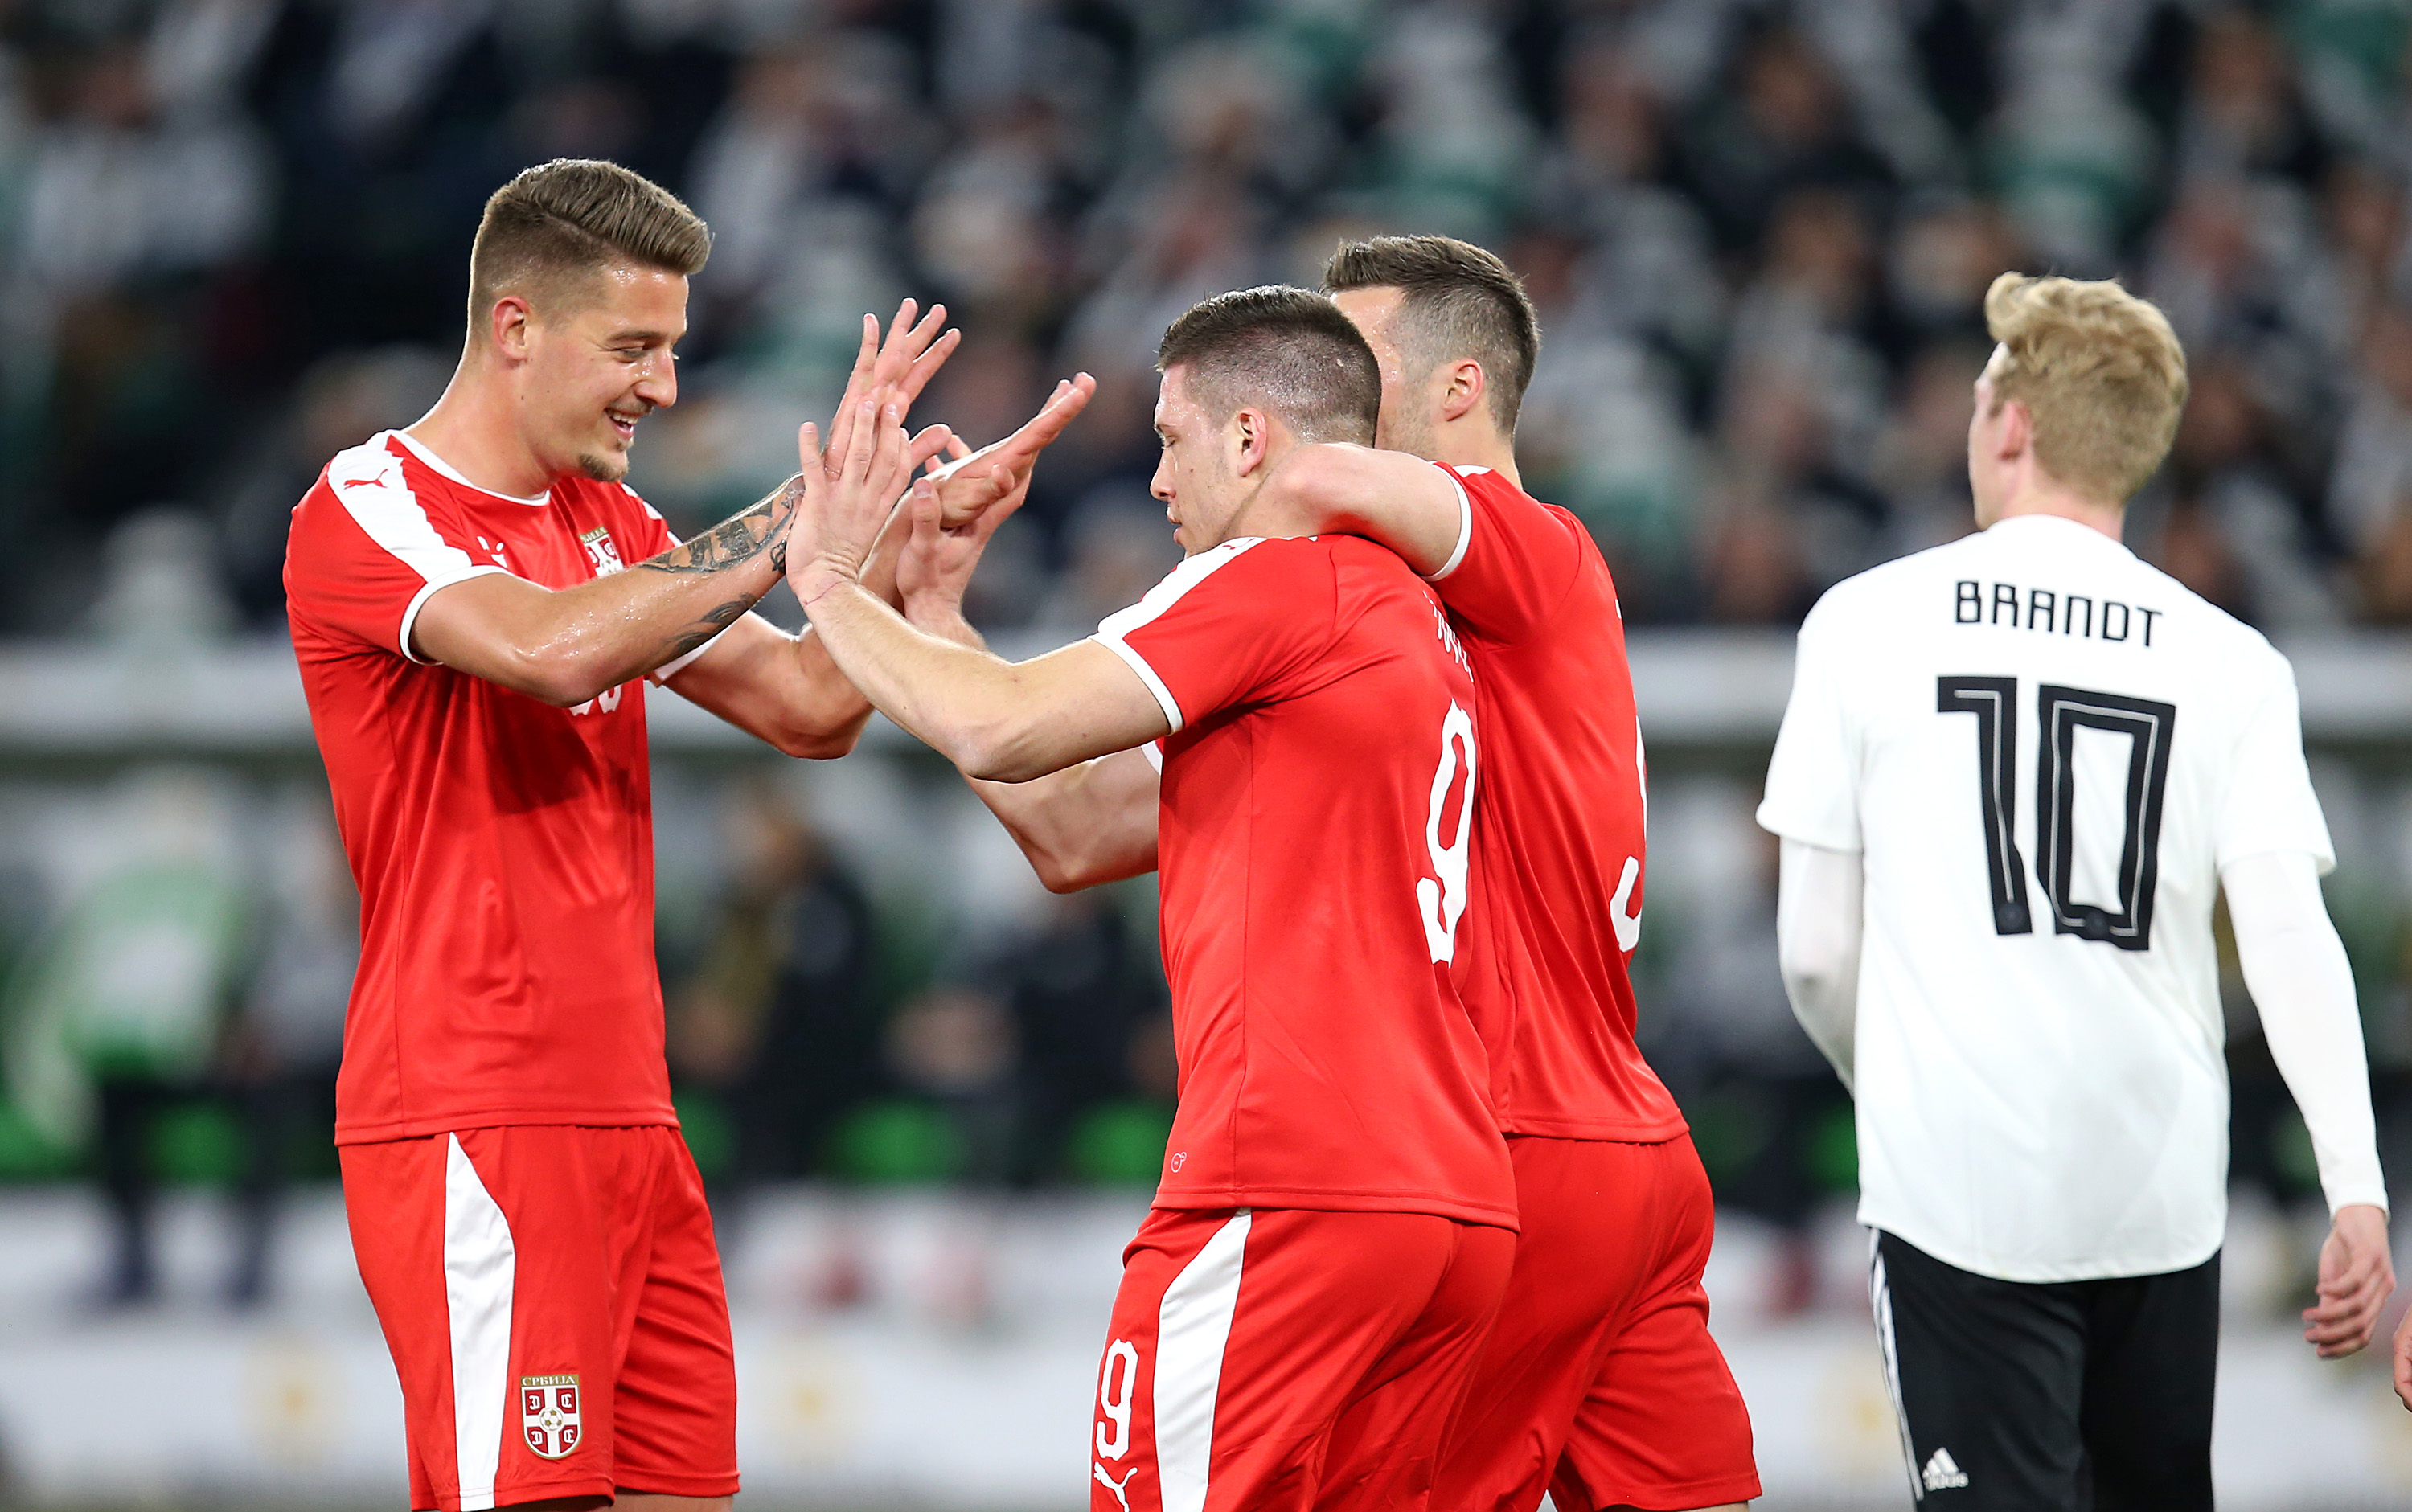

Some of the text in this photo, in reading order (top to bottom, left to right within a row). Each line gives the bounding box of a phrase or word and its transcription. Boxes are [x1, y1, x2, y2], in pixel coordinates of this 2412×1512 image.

[1955, 580, 2163, 647] BRANDT
[1416, 698, 1477, 969] 9
[1937, 675, 2176, 952] 10
[1096, 1338, 1139, 1461] 9
